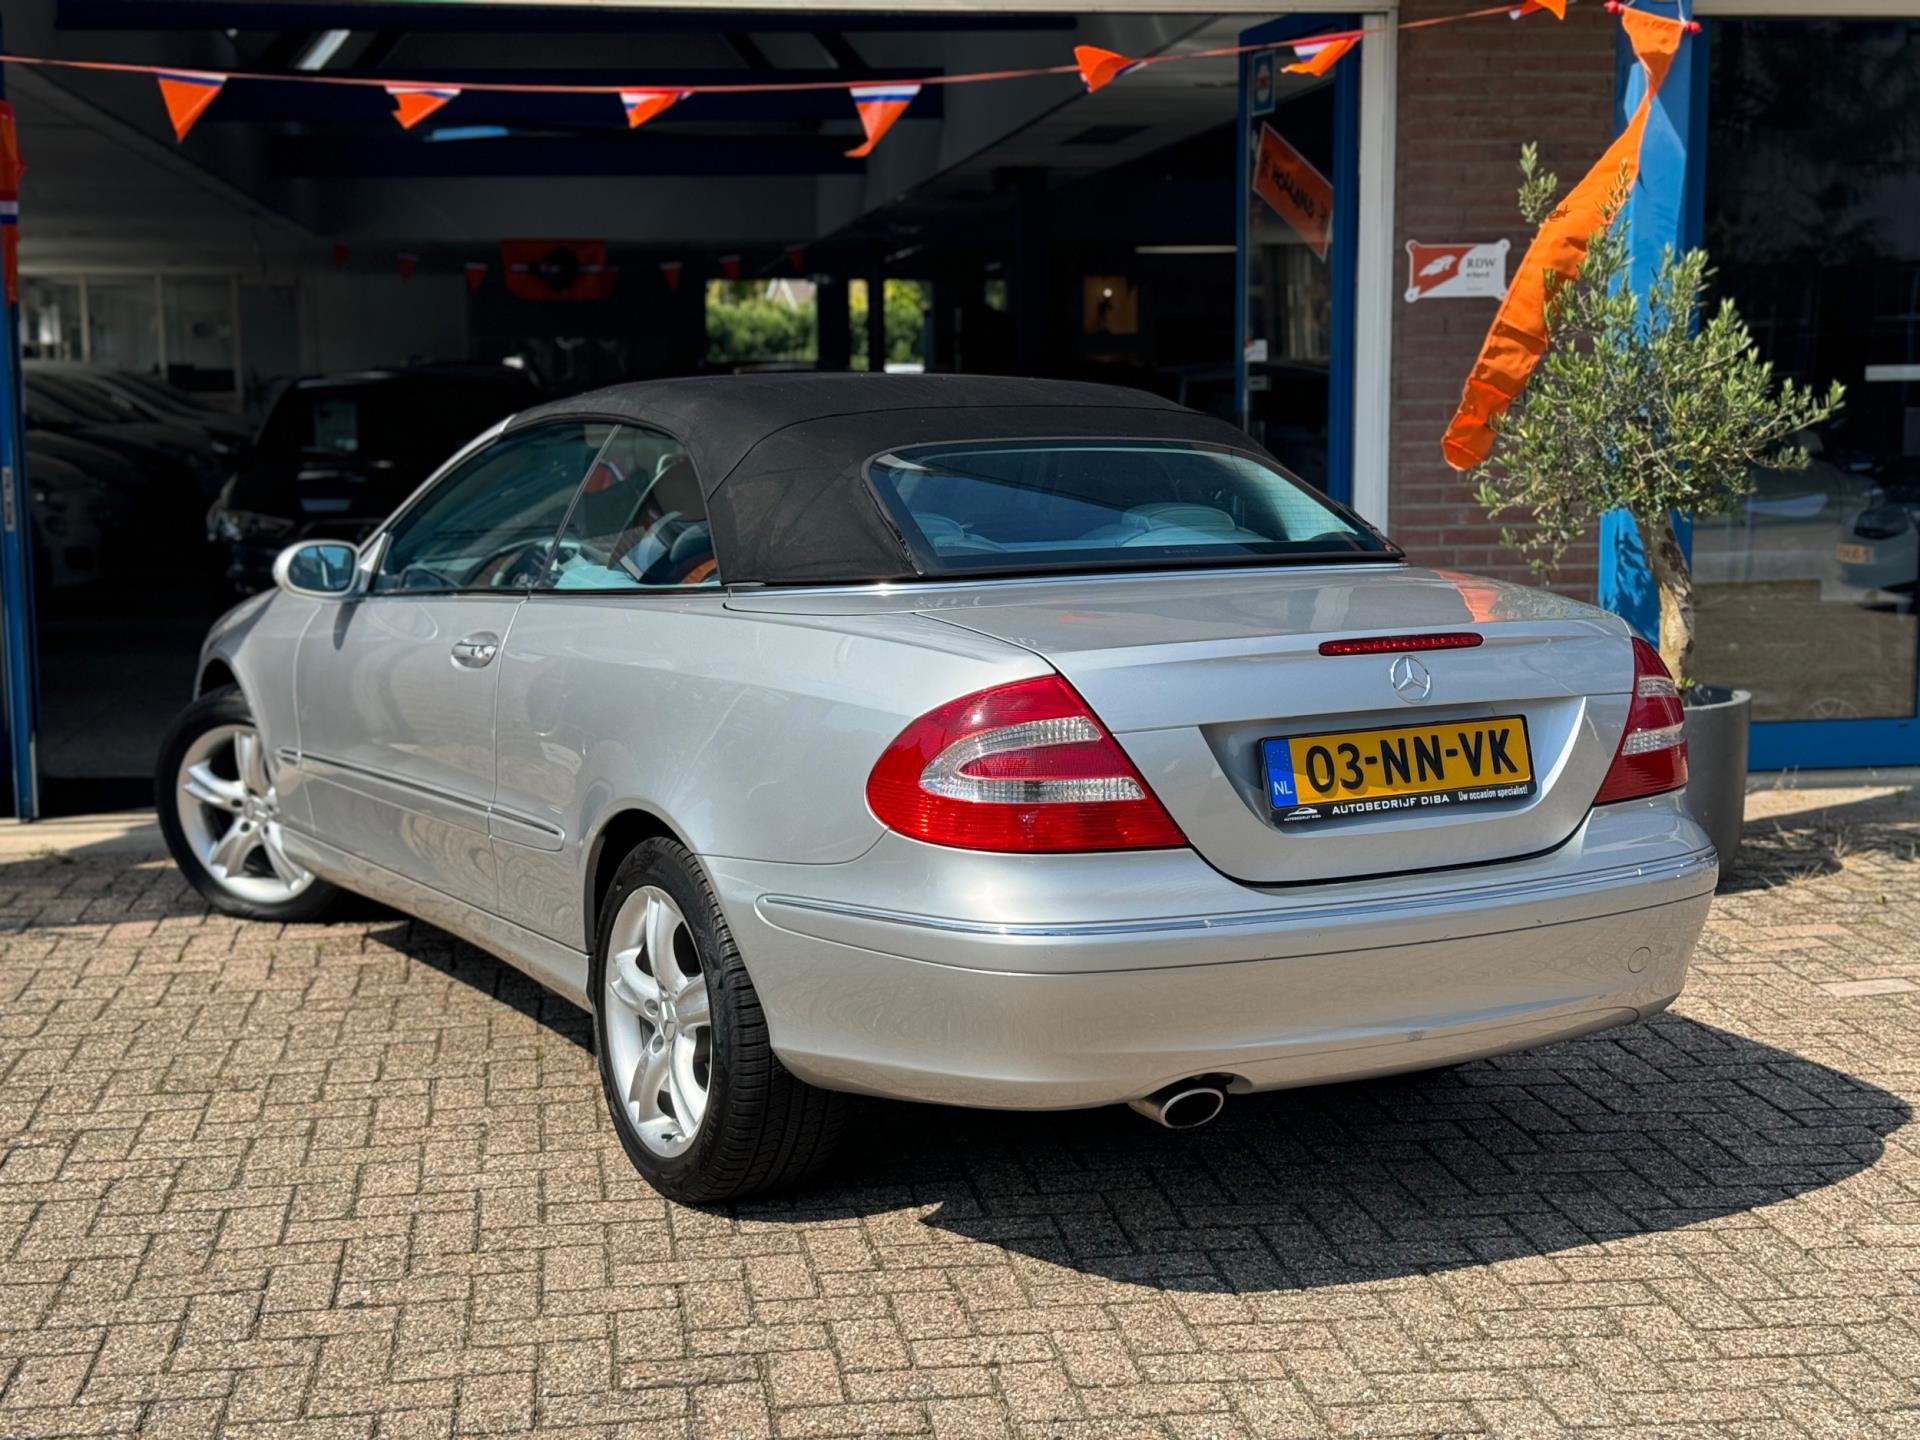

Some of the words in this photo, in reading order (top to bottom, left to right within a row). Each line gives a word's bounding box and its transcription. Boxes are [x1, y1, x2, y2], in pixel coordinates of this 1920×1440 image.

[1466, 257, 1497, 269] RDW
[1305, 728, 1519, 793] 03-NN-VK
[1273, 780, 1294, 796] NL
[1331, 797, 1417, 816] AUTOBEDRIJF
[1420, 794, 1450, 806] DIBA
[1457, 790, 1468, 801] Uw
[1469, 788, 1497, 801] occasion
[1497, 784, 1529, 799] specialist!
